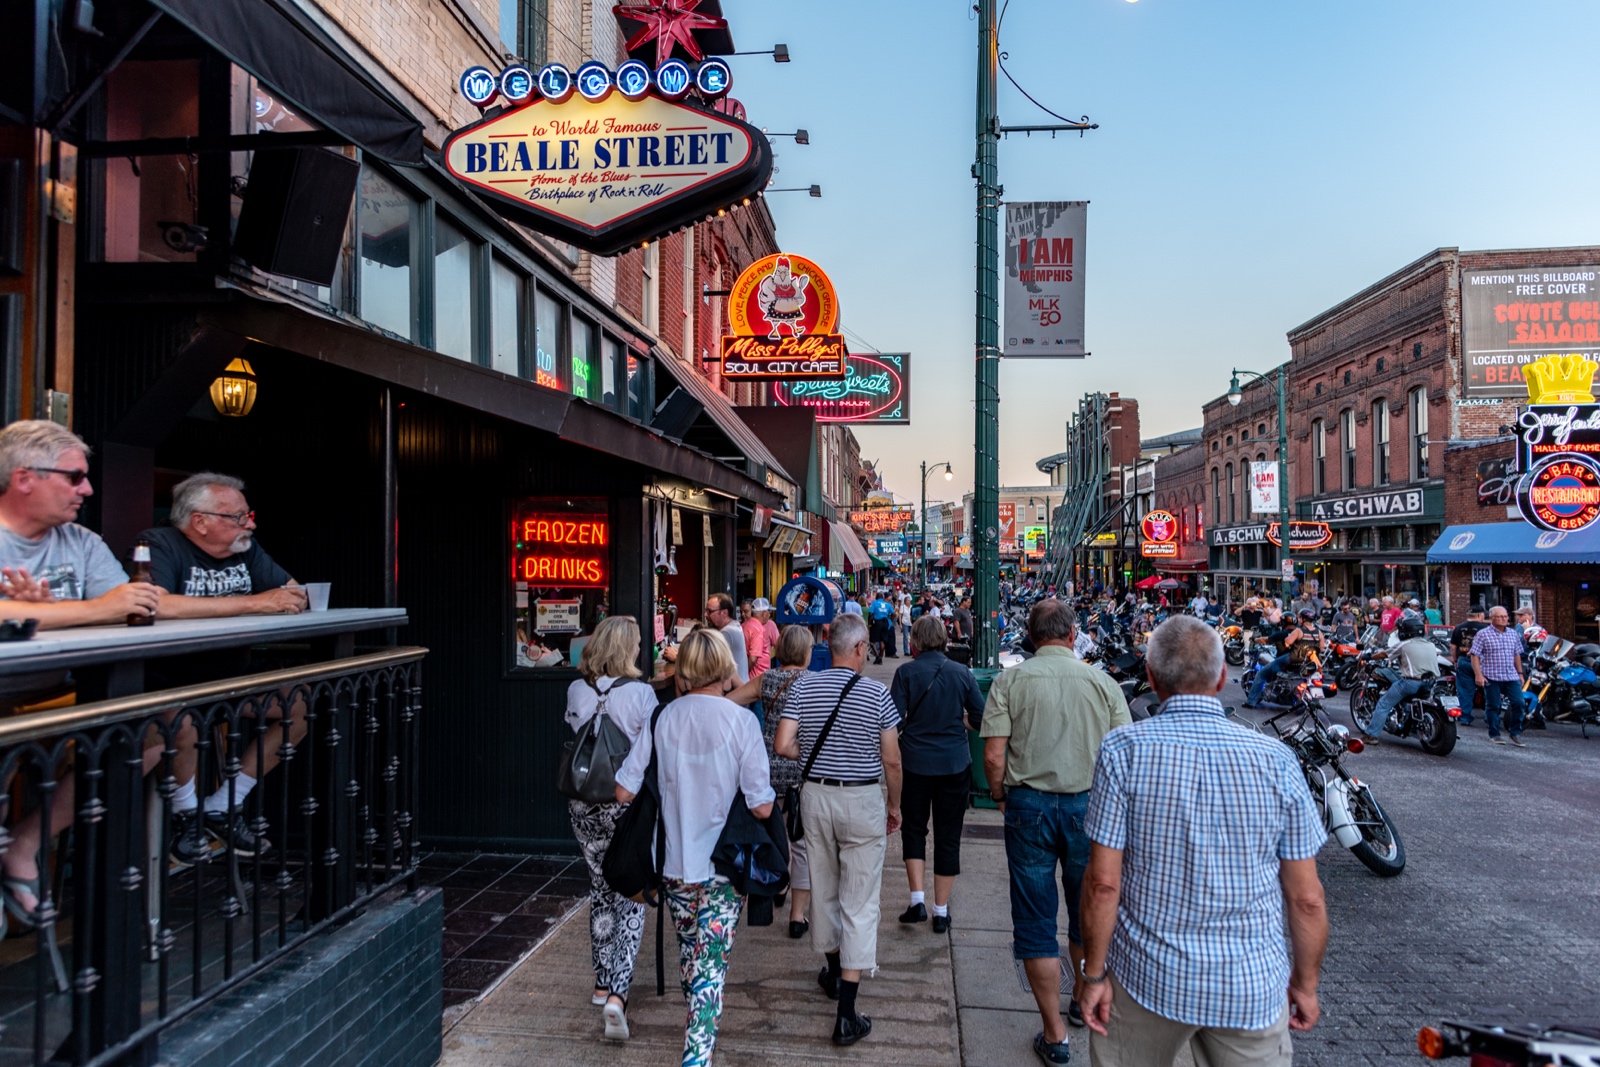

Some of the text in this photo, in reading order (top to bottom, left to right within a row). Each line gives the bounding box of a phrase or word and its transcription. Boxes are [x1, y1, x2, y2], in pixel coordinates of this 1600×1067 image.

[465, 65, 730, 98] WELCOME
[532, 117, 662, 137] to World Famous
[464, 132, 733, 174] BEALE STREET
[530, 171, 637, 187] Home of the Blues
[524, 187, 586, 204] Birthplace
[587, 188, 599, 203] of
[1015, 204, 1033, 222] AM
[1019, 219, 1034, 238] MAN
[1020, 237, 1073, 264] I AM
[1019, 269, 1073, 282] MEMPHIS
[1471, 271, 1595, 286] MENTION THIS BILLBOARD
[739, 270, 758, 300] PEACE
[756, 261, 774, 276] AND
[797, 262, 827, 292] CHICKEN
[820, 291, 832, 327] GREASE
[1516, 283, 1587, 296] FREE COVER
[1029, 299, 1060, 311] MLK
[1493, 300, 1564, 323] COYOTE
[1040, 311, 1062, 327] 50
[724, 337, 776, 357] Miss
[724, 361, 839, 374] SOUL CITY CAFE
[1472, 355, 1515, 366] LOCATED
[1517, 354, 1531, 364] ON
[1485, 366, 1527, 383] BEA
[1519, 411, 1567, 445] Jerry
[1560, 444, 1571, 452] OF
[1574, 443, 1600, 452] FAME
[1261, 473, 1275, 482] AM
[1550, 462, 1586, 478] BAR
[1333, 491, 1421, 516] SCHWAB
[1532, 486, 1600, 504] RESTAURANT
[851, 512, 911, 522] KING'S PALACE
[864, 520, 899, 531] CAFE
[1147, 513, 1171, 523] PIG
[524, 520, 605, 545] FROZEN
[1228, 526, 1266, 543] SCHW
[1287, 525, 1328, 539] chwab
[189, 562, 250, 581] HARLEY
[524, 557, 601, 582] DRINKS
[1473, 568, 1490, 582] BEER
